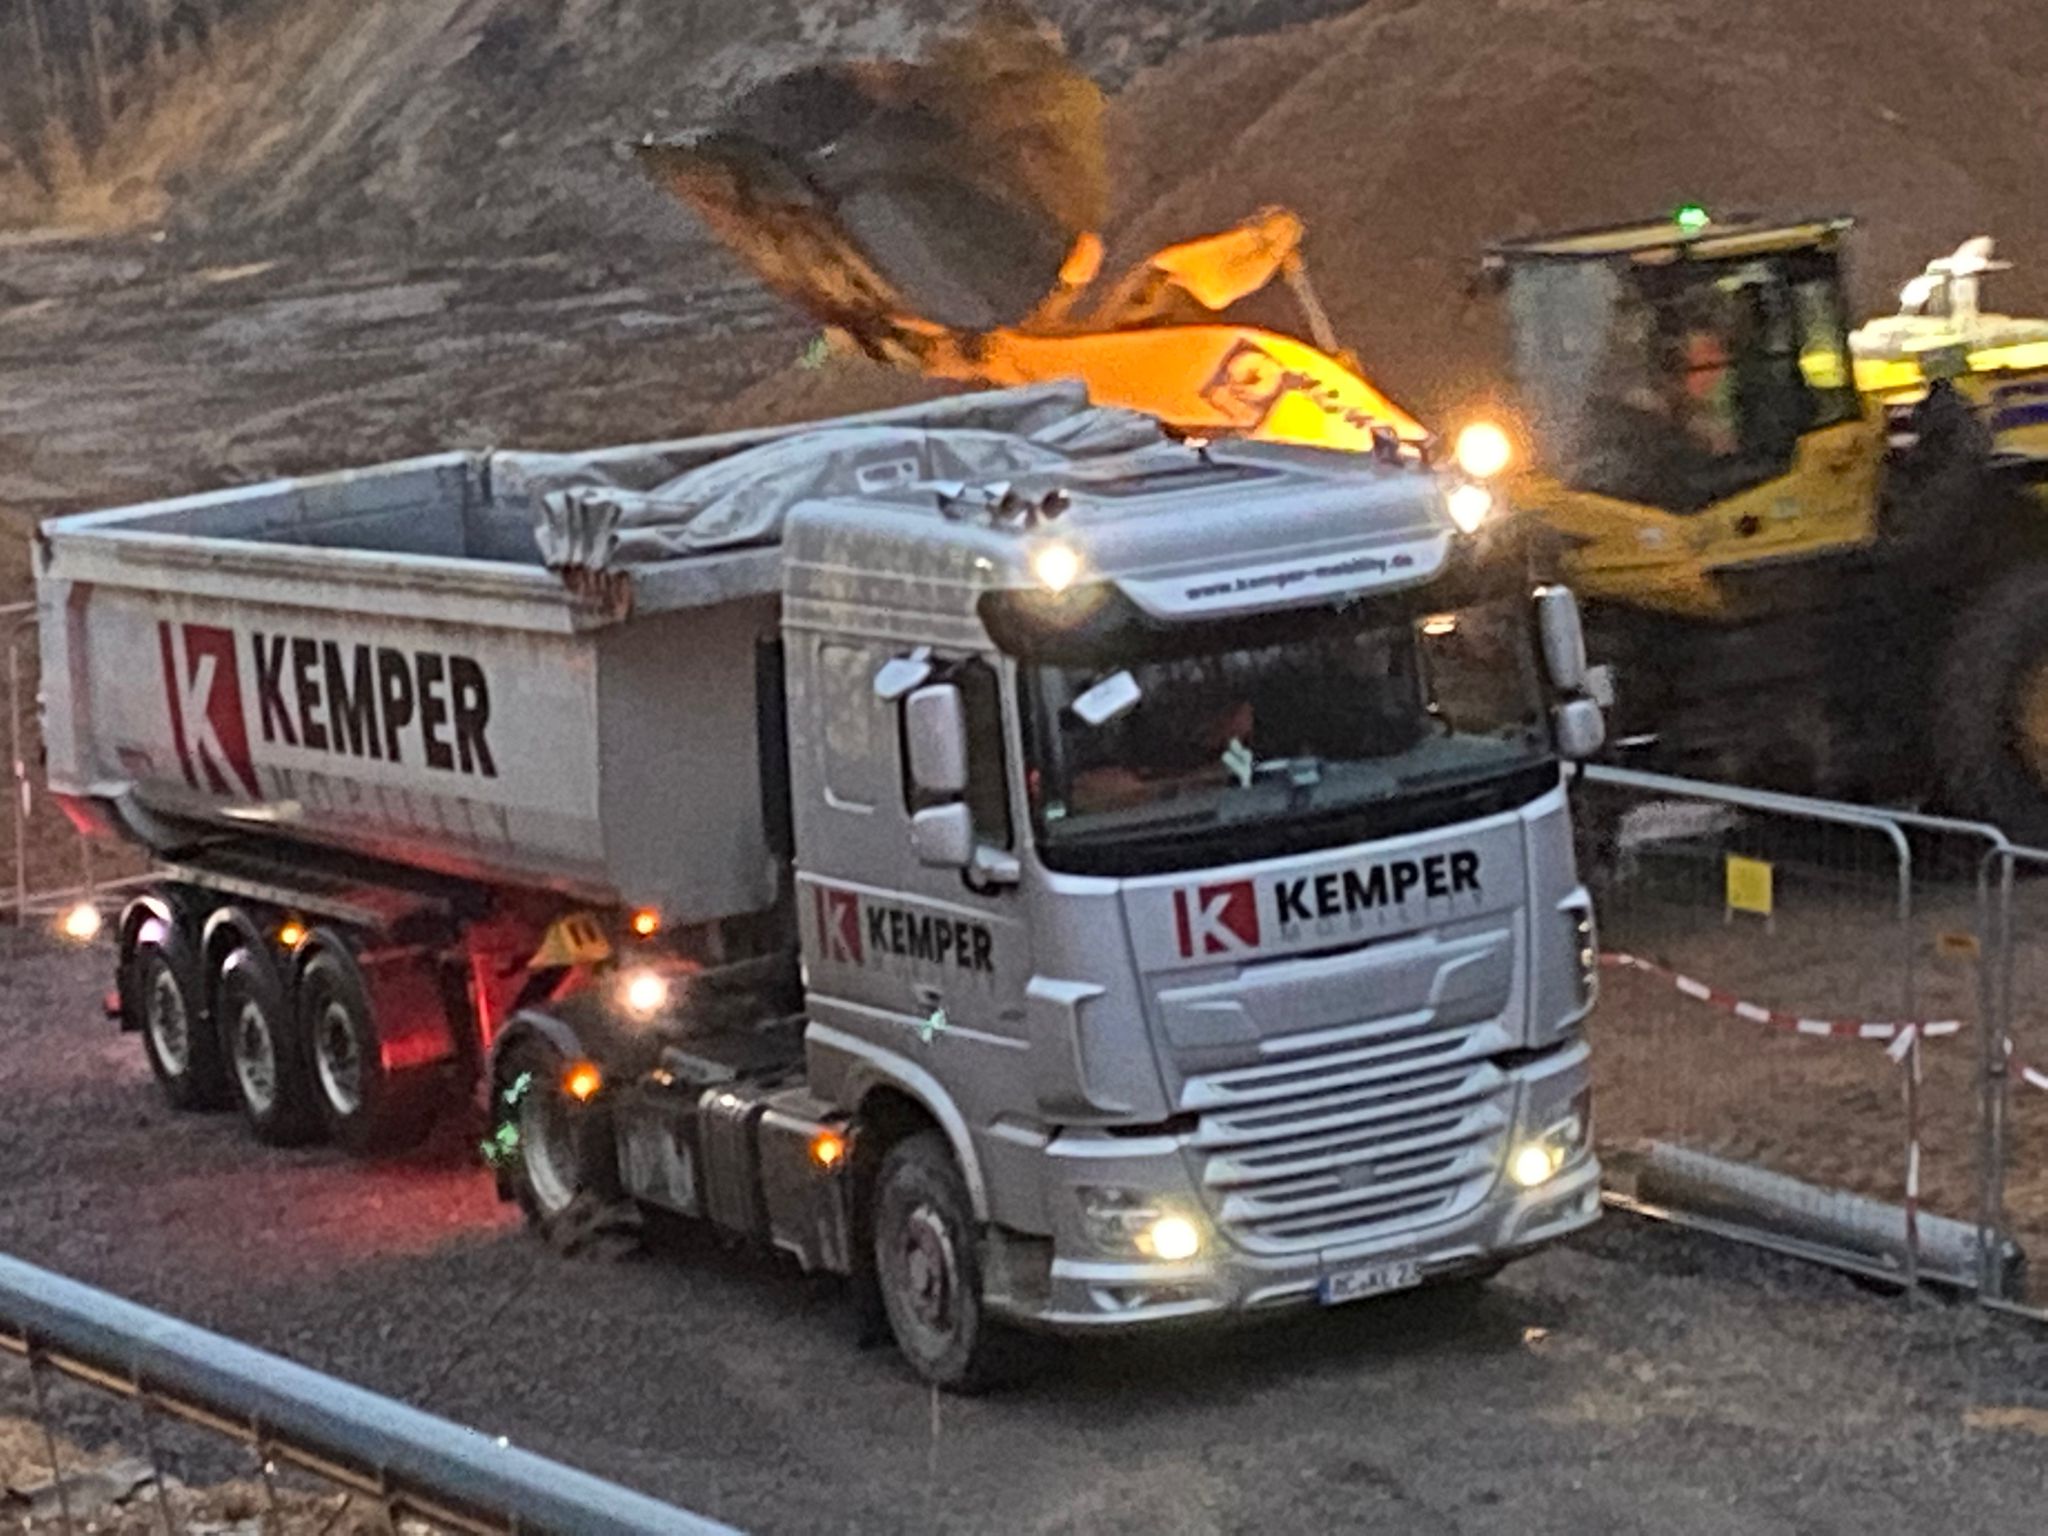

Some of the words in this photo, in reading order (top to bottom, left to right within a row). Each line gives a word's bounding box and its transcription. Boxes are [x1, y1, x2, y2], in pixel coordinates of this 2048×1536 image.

[252, 630, 498, 779] KEMPER
[1274, 849, 1482, 924] KEMPER
[866, 905, 994, 973] KEMPER
